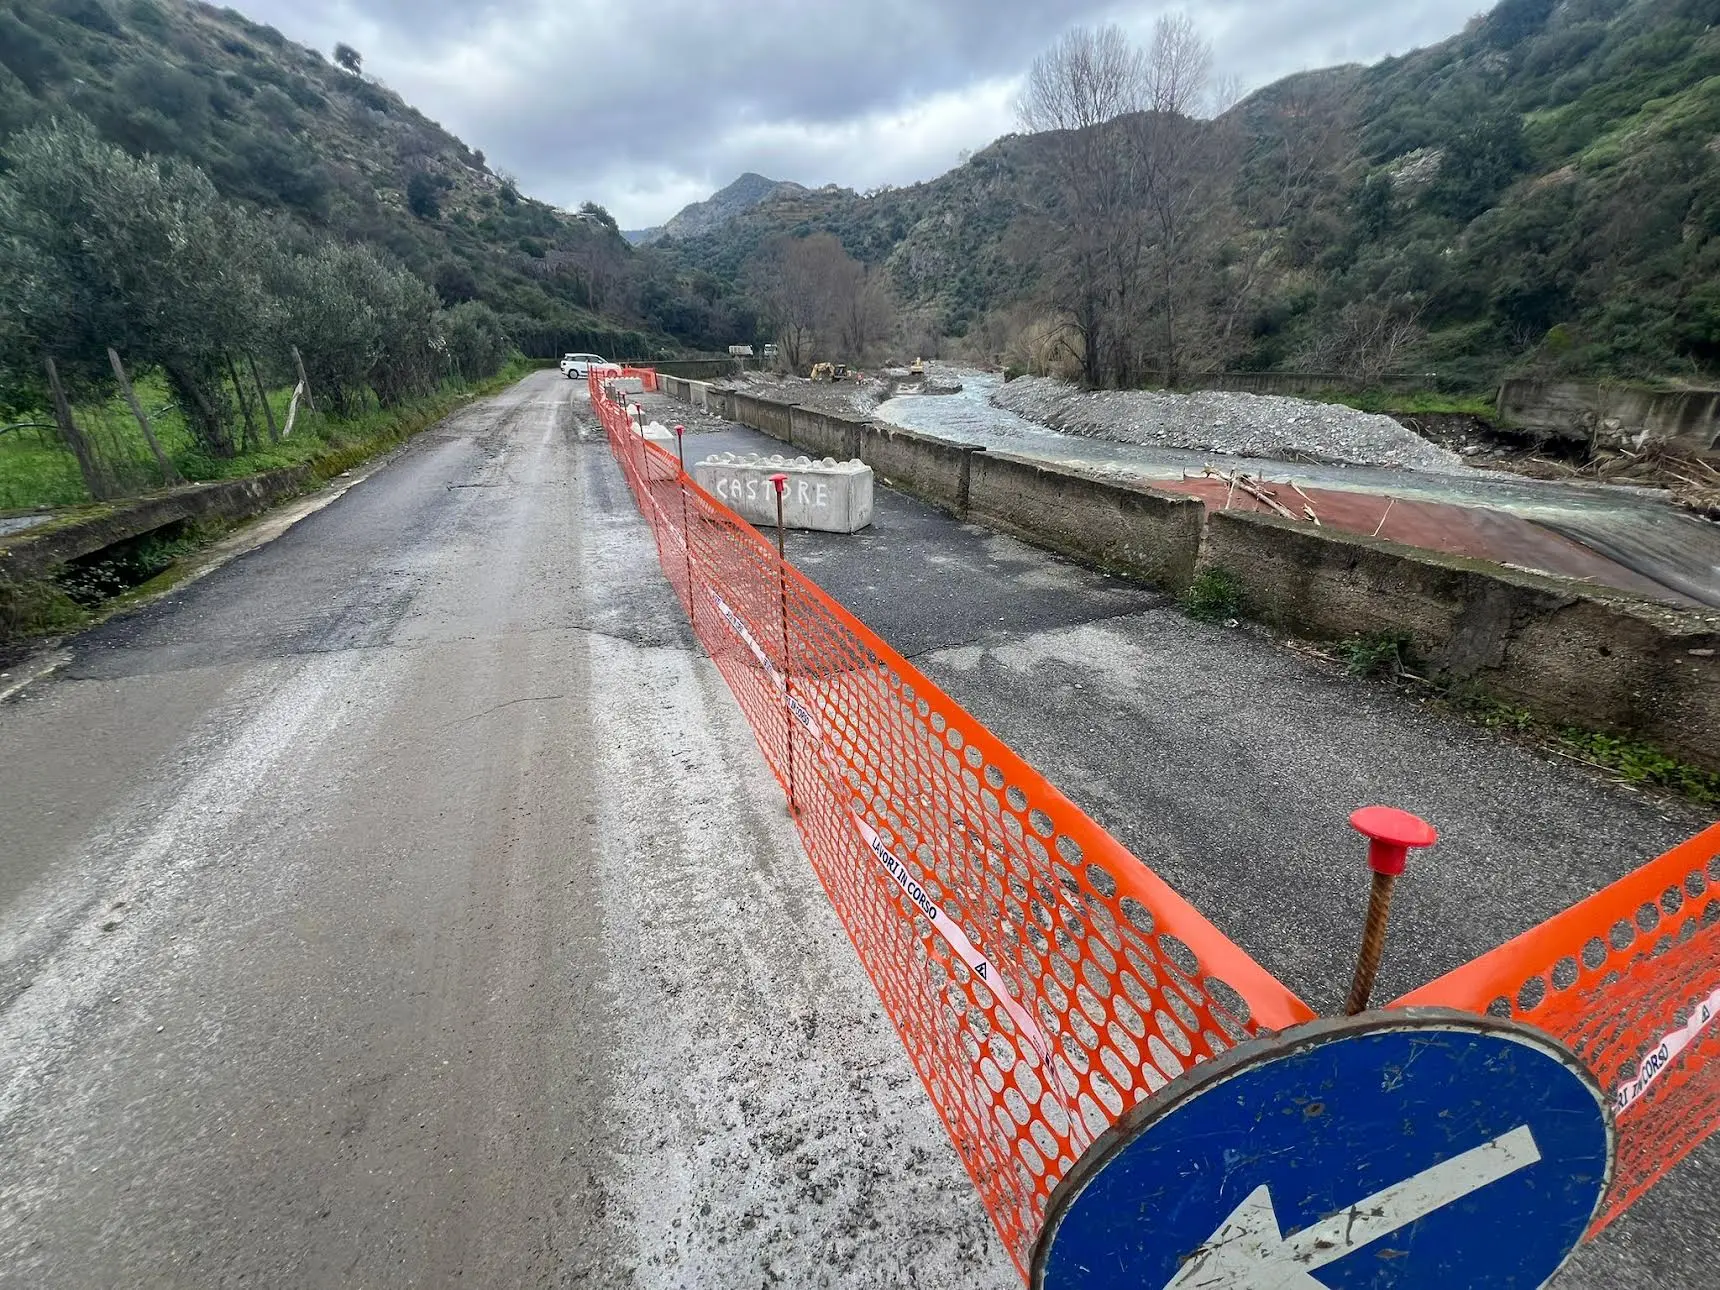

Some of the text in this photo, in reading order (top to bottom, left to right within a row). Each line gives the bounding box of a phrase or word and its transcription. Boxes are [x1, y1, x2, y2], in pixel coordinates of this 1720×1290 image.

[871, 837, 937, 920] LAVORI IN CORSO
[1642, 1043, 1669, 1084] CORSO
